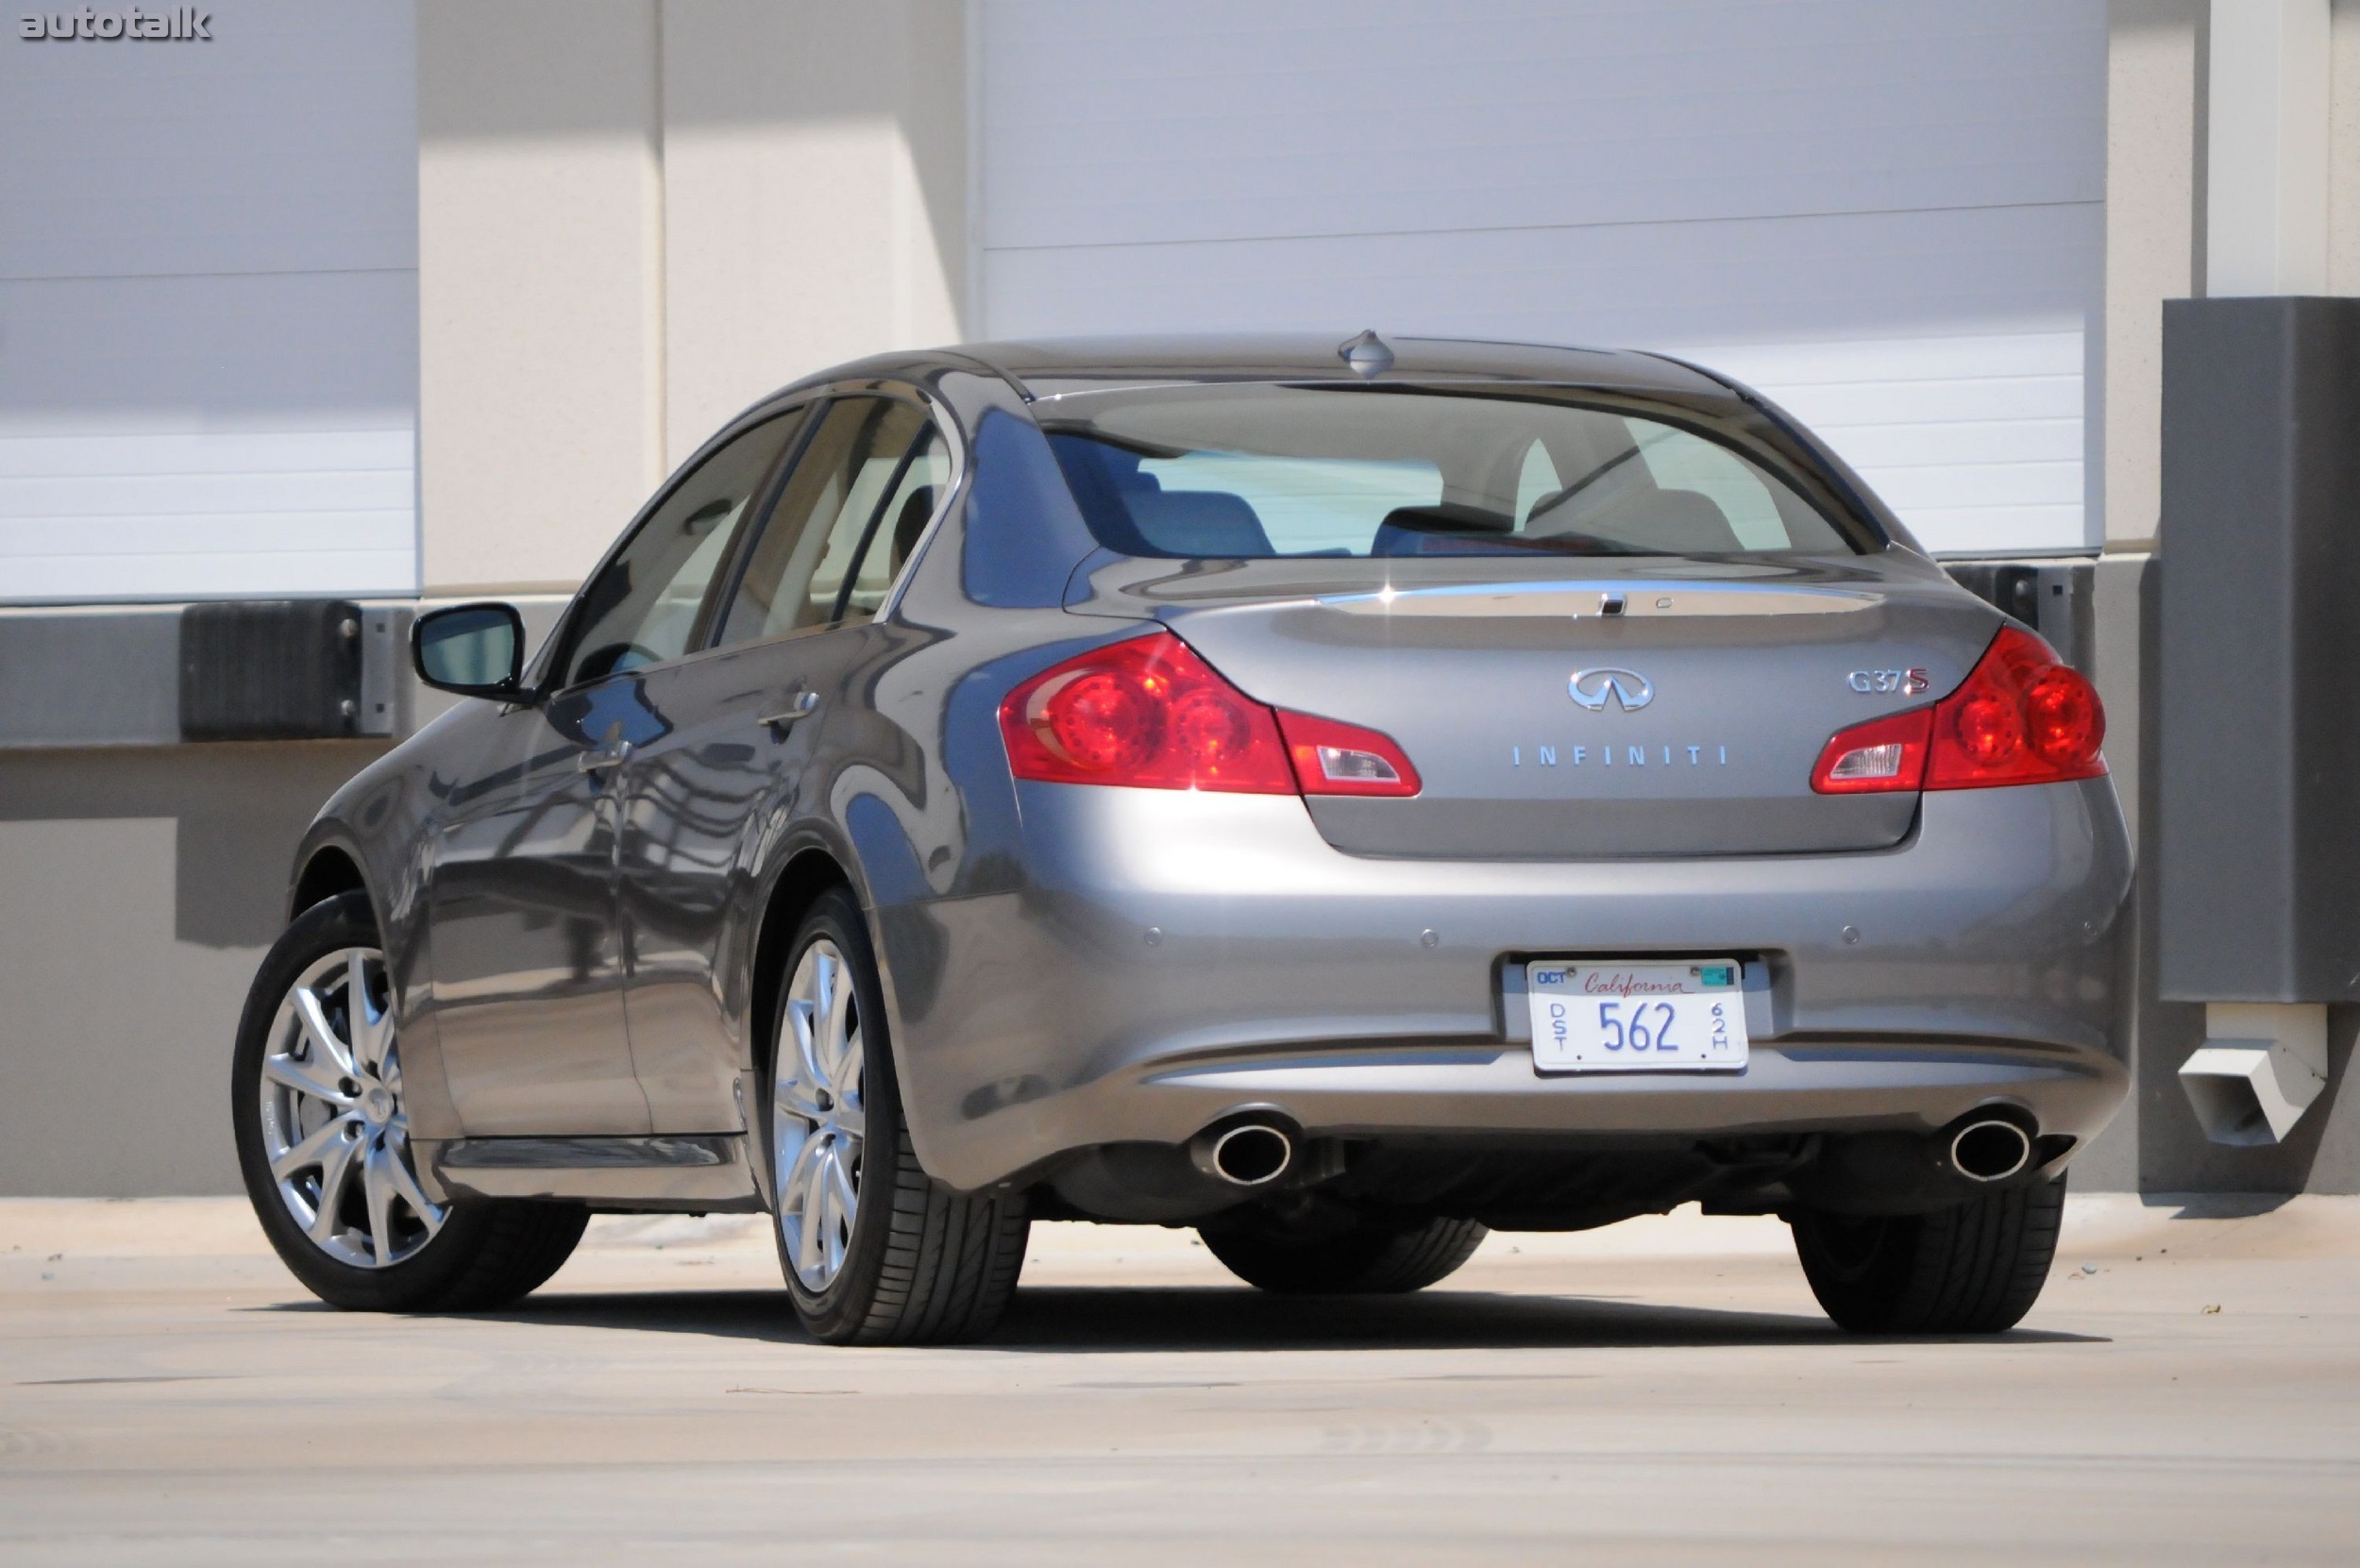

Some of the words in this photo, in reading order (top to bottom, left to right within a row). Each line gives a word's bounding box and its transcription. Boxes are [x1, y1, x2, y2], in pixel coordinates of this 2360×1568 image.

[1512, 744, 1728, 767] INFINITI
[1537, 970, 1566, 985] OCT
[1584, 972, 1695, 999] California
[1598, 1002, 1679, 1053] 562
